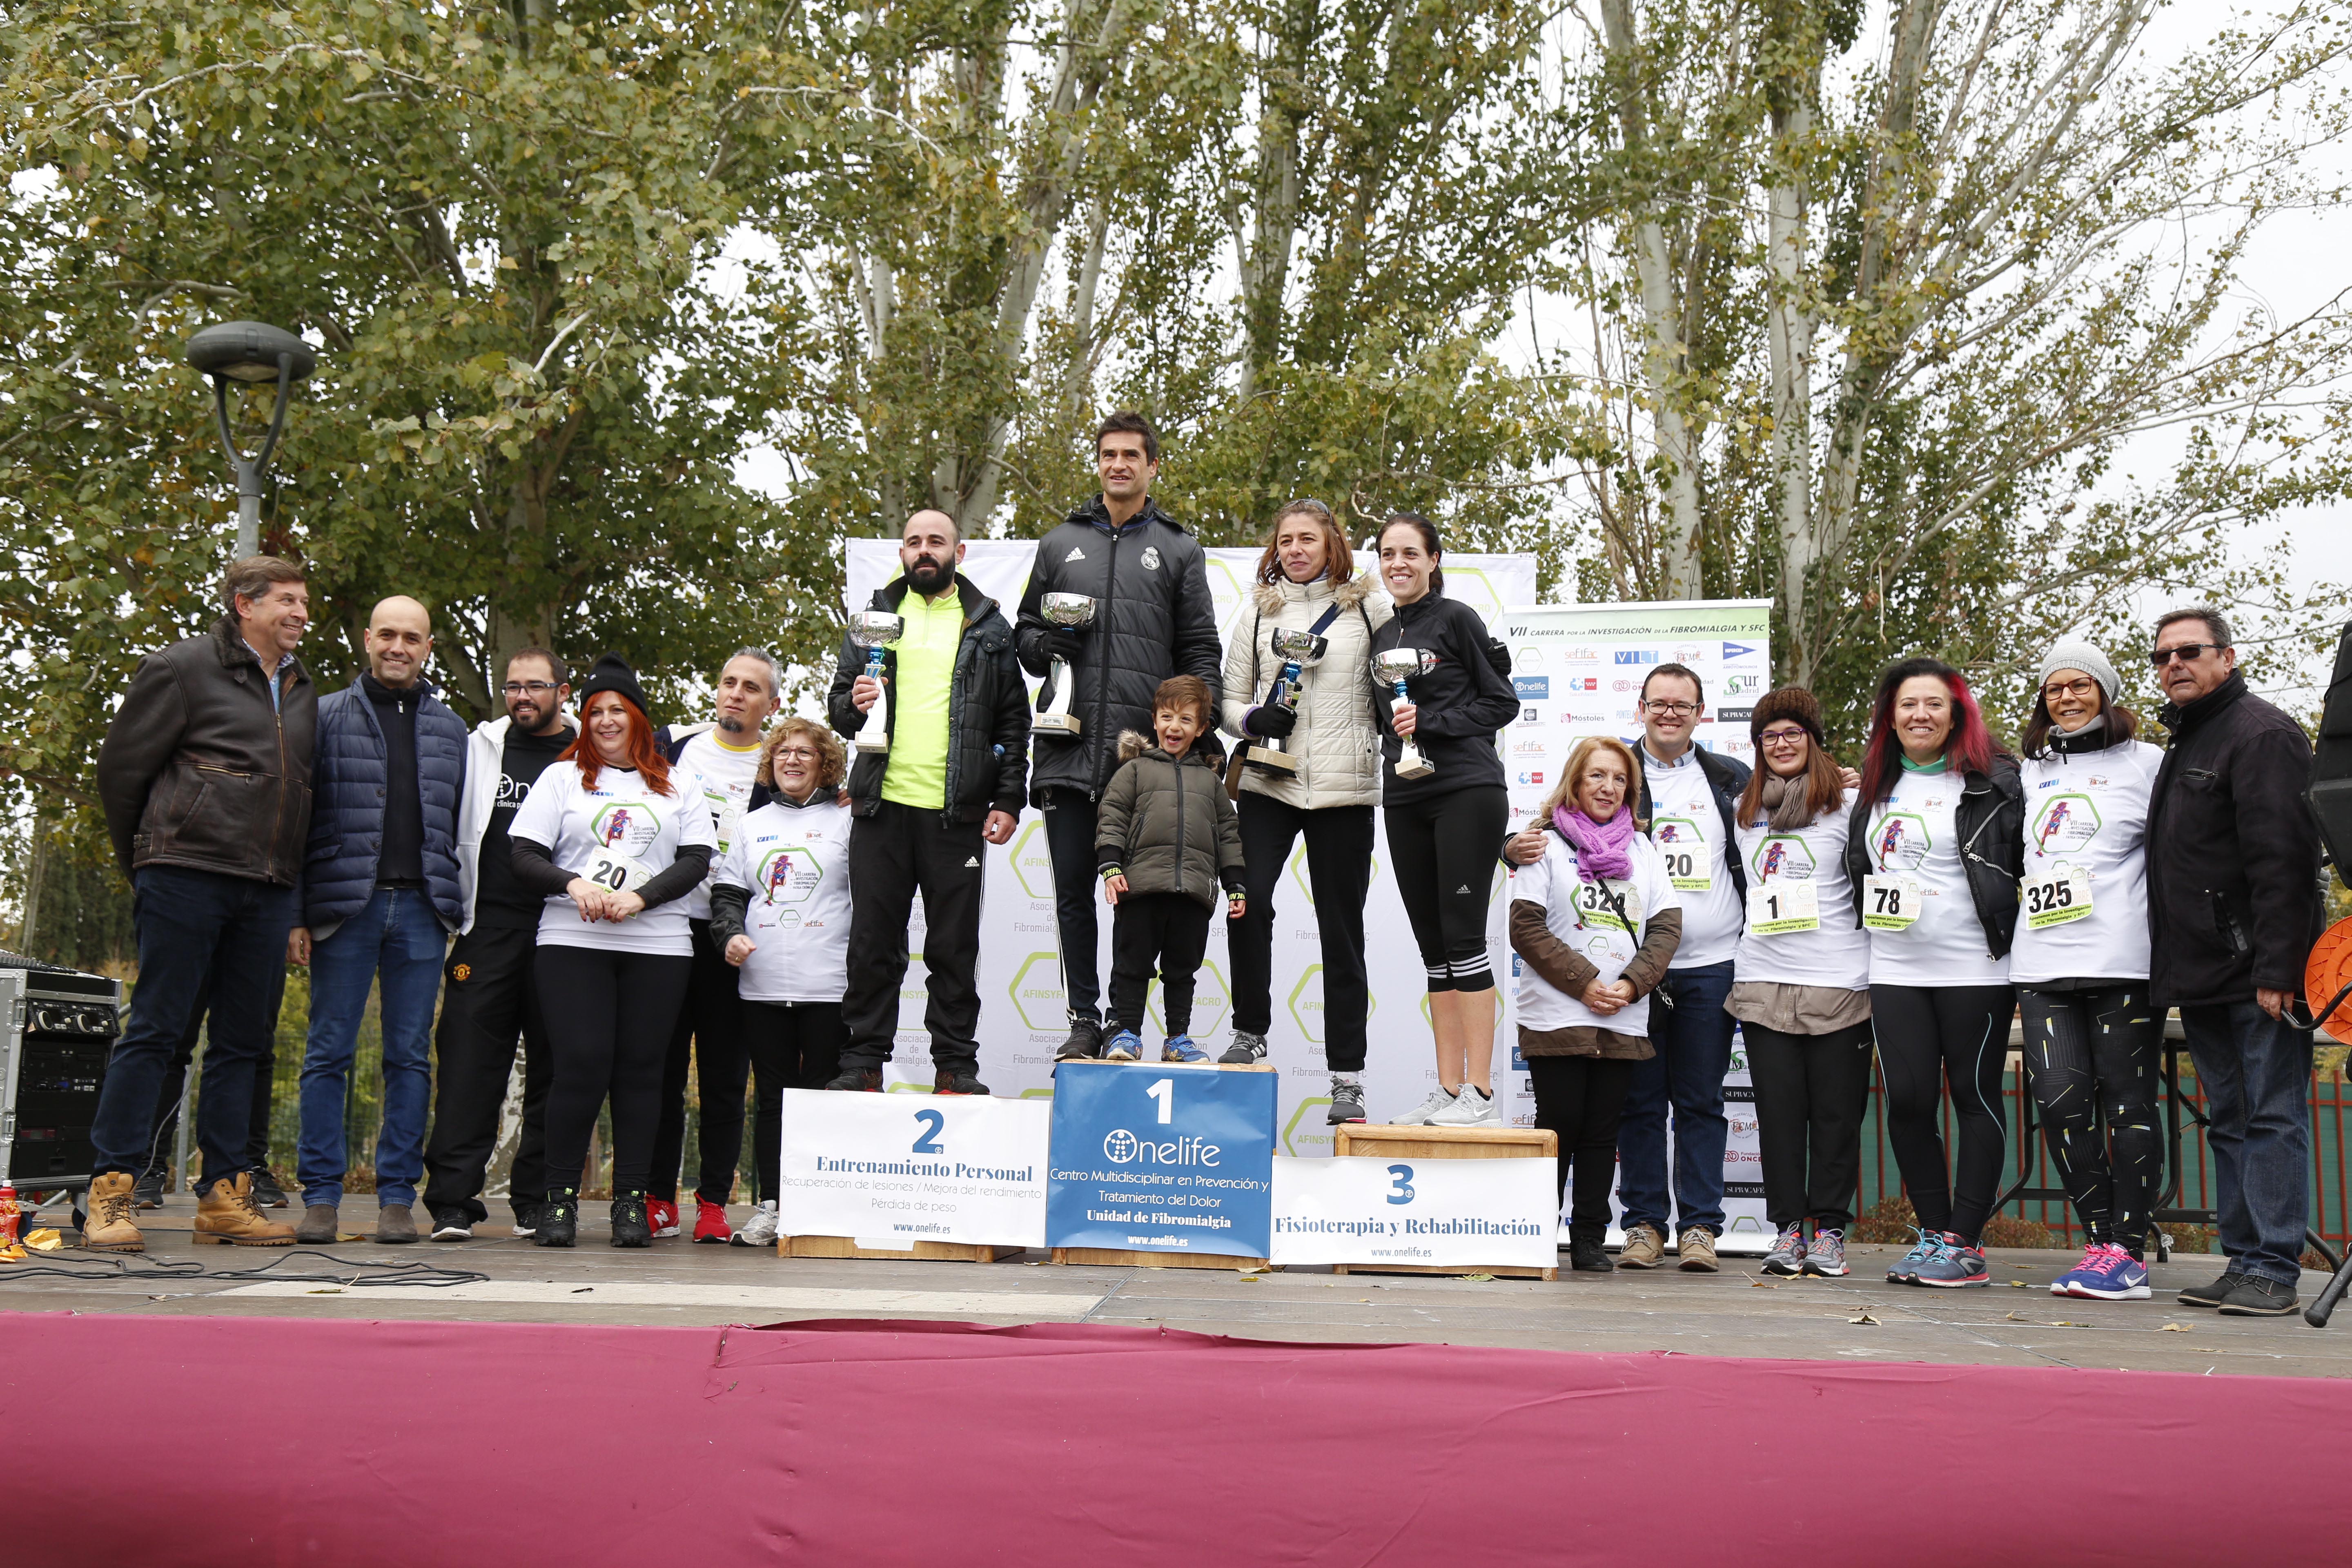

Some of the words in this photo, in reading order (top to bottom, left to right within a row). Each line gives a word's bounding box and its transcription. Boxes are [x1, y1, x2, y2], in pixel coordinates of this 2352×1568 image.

[1510, 627, 1528, 636] VII
[1588, 626, 1652, 635] INVESTIGACIÓN
[1670, 625, 1737, 633] FIBROMIALGIA
[1616, 651, 1656, 664] VILT
[1515, 682, 1546, 691] Onelife
[1729, 684, 1759, 693] Madrid
[592, 860, 626, 890] 20
[1875, 888, 1900, 914] 78
[2028, 880, 2071, 913] 325
[1030, 902, 1055, 910] Asocia
[1767, 895, 1777, 919] 1
[914, 911, 923, 920] de
[1047, 913, 1056, 921] de
[1014, 922, 1056, 934] Fibromialg
[1212, 928, 1226, 937] SFC
[1486, 936, 1499, 946] SFC
[1023, 990, 1065, 998] AFINSYFA
[1029, 1034, 1069, 1043] Asociació
[909, 1045, 919, 1054] de
[1046, 1045, 1055, 1054] de
[1013, 1054, 1056, 1067] Fibromialg
[1146, 1079, 1173, 1124] 1
[1512, 1114, 1537, 1124] sefif
[913, 1109, 944, 1154] 2
[1104, 1129, 1221, 1167] Onelife
[817, 1156, 950, 1177] Entrenamiento
[955, 1163, 1032, 1182] Personal
[1050, 1168, 1088, 1181] Centro
[1091, 1170, 1174, 1186] Multidisciplinar
[1178, 1177, 1192, 1186] en
[1196, 1175, 1258, 1189] Prevención
[1261, 1182, 1269, 1192] y
[1387, 1164, 1415, 1205] 3
[782, 1176, 851, 1189] Recuperación
[855, 1178, 869, 1189] de
[872, 1179, 913, 1192] lesiones
[917, 1183, 922, 1192] /
[924, 1183, 957, 1195] Mejora
[961, 1184, 976, 1195] del
[980, 1187, 1042, 1198] rendimiento
[1099, 1190, 1164, 1204] Tratamiento
[1168, 1194, 1186, 1205] del
[1190, 1195, 1221, 1207] Dolor
[872, 1198, 910, 1210] Pérdida
[914, 1200, 928, 1211] de
[931, 1203, 956, 1212] peso
[1087, 1209, 1131, 1222] Unidad
[1134, 1211, 1148, 1223] de
[1152, 1212, 1231, 1229] Fibromialgia
[893, 1223, 951, 1234] www.onelife.es
[1275, 1217, 1384, 1236] Fisioterapia
[1390, 1222, 1399, 1237] y
[1405, 1218, 1541, 1236] Rehabilitación
[1128, 1235, 1188, 1247] www.onelife.es
[1371, 1247, 1432, 1257] www.onelife.es
